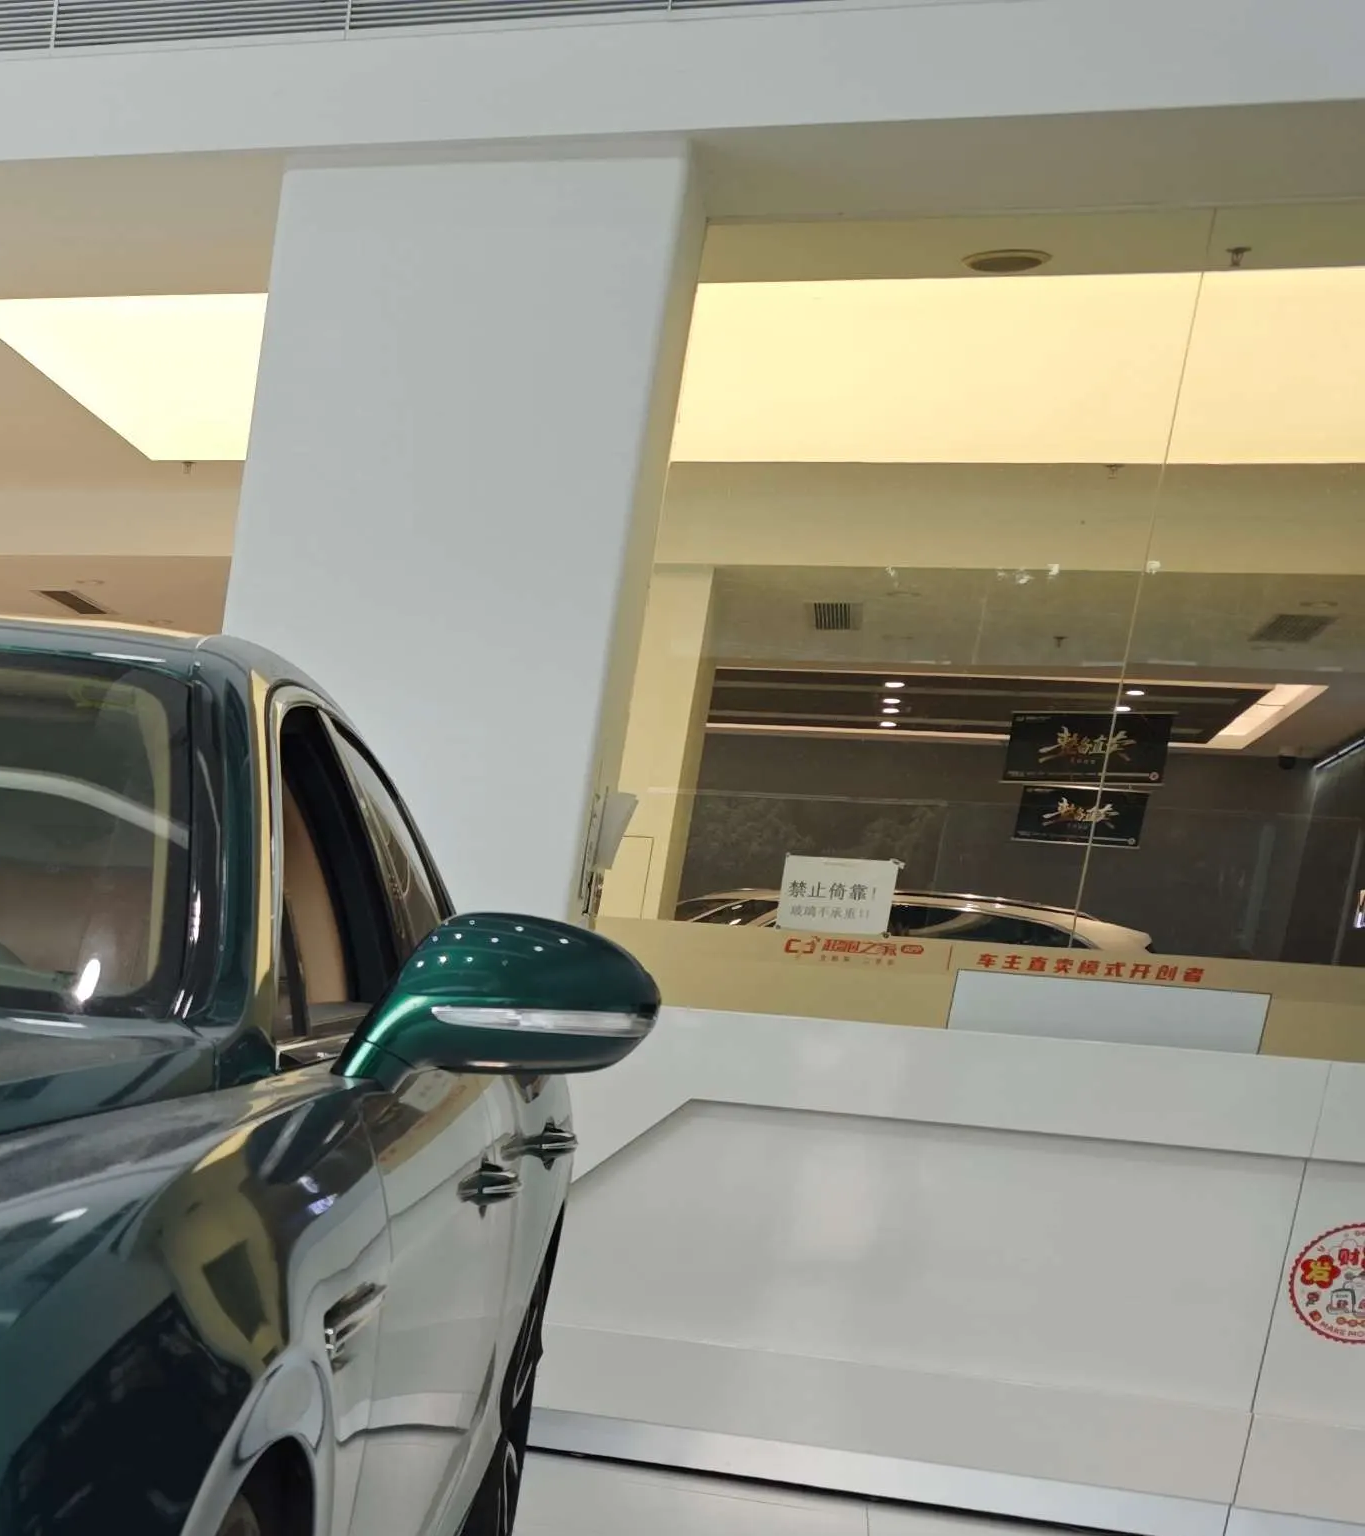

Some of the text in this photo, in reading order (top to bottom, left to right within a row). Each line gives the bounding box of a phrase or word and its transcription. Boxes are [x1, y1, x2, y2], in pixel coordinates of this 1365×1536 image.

[976, 953, 1206, 983] 车主直卖模式开创者
